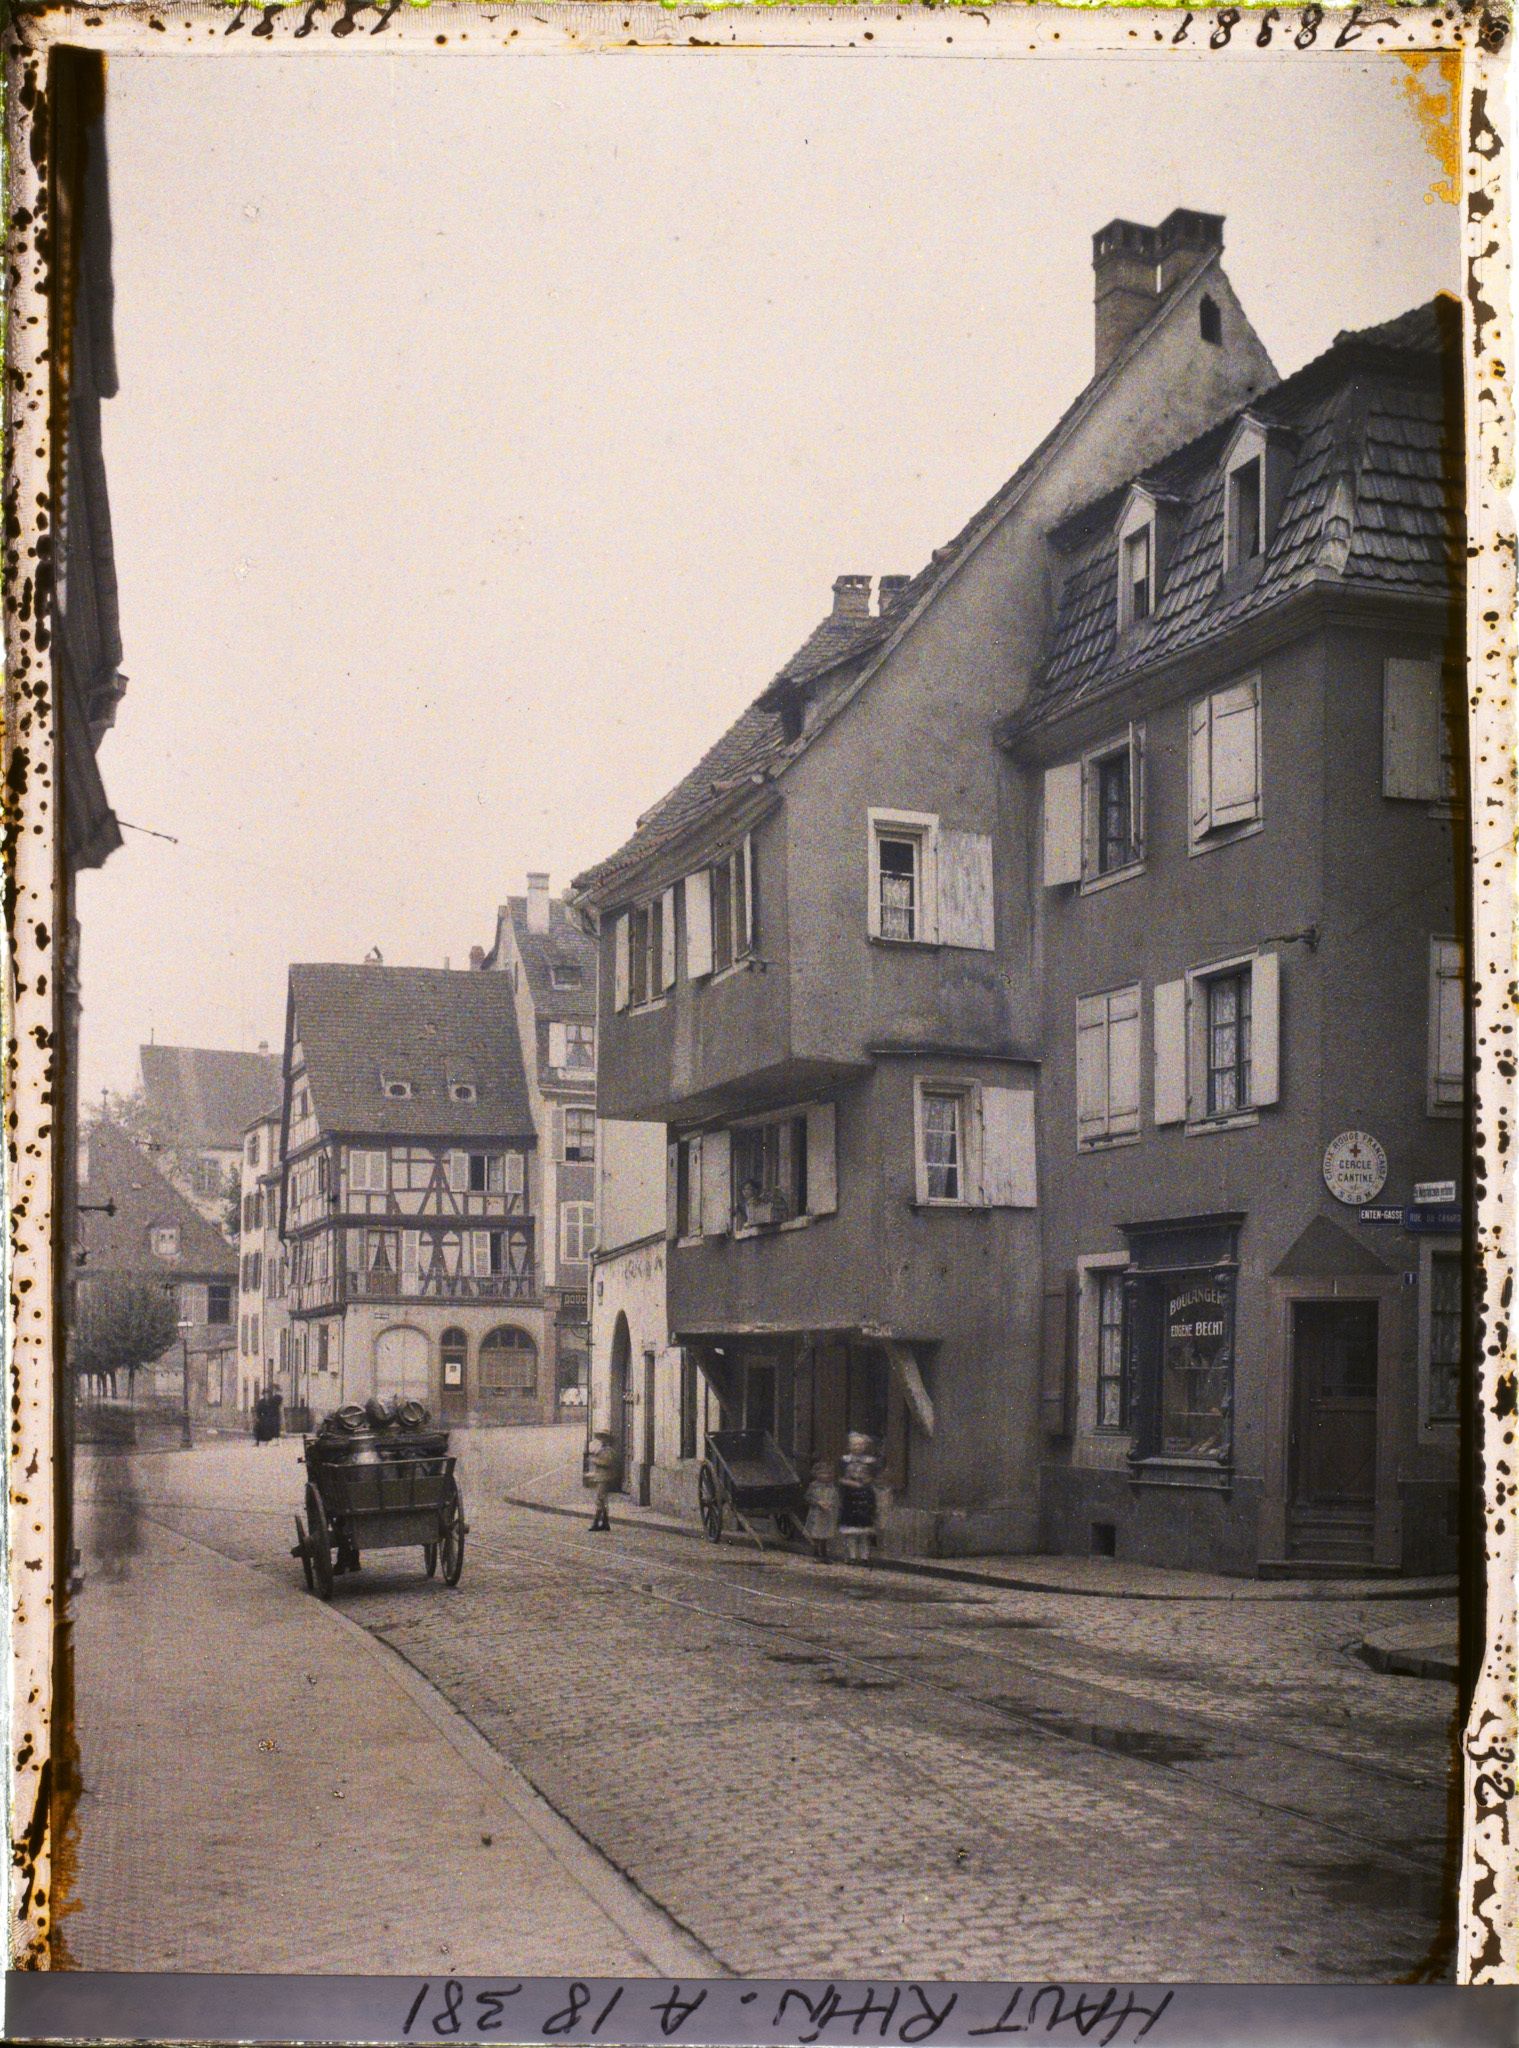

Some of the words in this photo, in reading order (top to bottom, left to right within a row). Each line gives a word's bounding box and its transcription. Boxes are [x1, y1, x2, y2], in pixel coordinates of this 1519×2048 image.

[1324, 1151, 1335, 1181] CROIX
[1332, 1132, 1359, 1150] ROUGE
[1338, 1159, 1372, 1170] CERCLE
[1337, 1173, 1373, 1183] CANTINE
[1360, 1209, 1404, 1220] ENTEN-GASSE
[1409, 1212, 1422, 1223] RUE
[1195, 1320, 1224, 1337] BECHT
[401, 1979, 522, 2036] 381
[540, 1982, 625, 2036] 18
[649, 1984, 708, 2036] A
[967, 1984, 1175, 2047] HAUT
